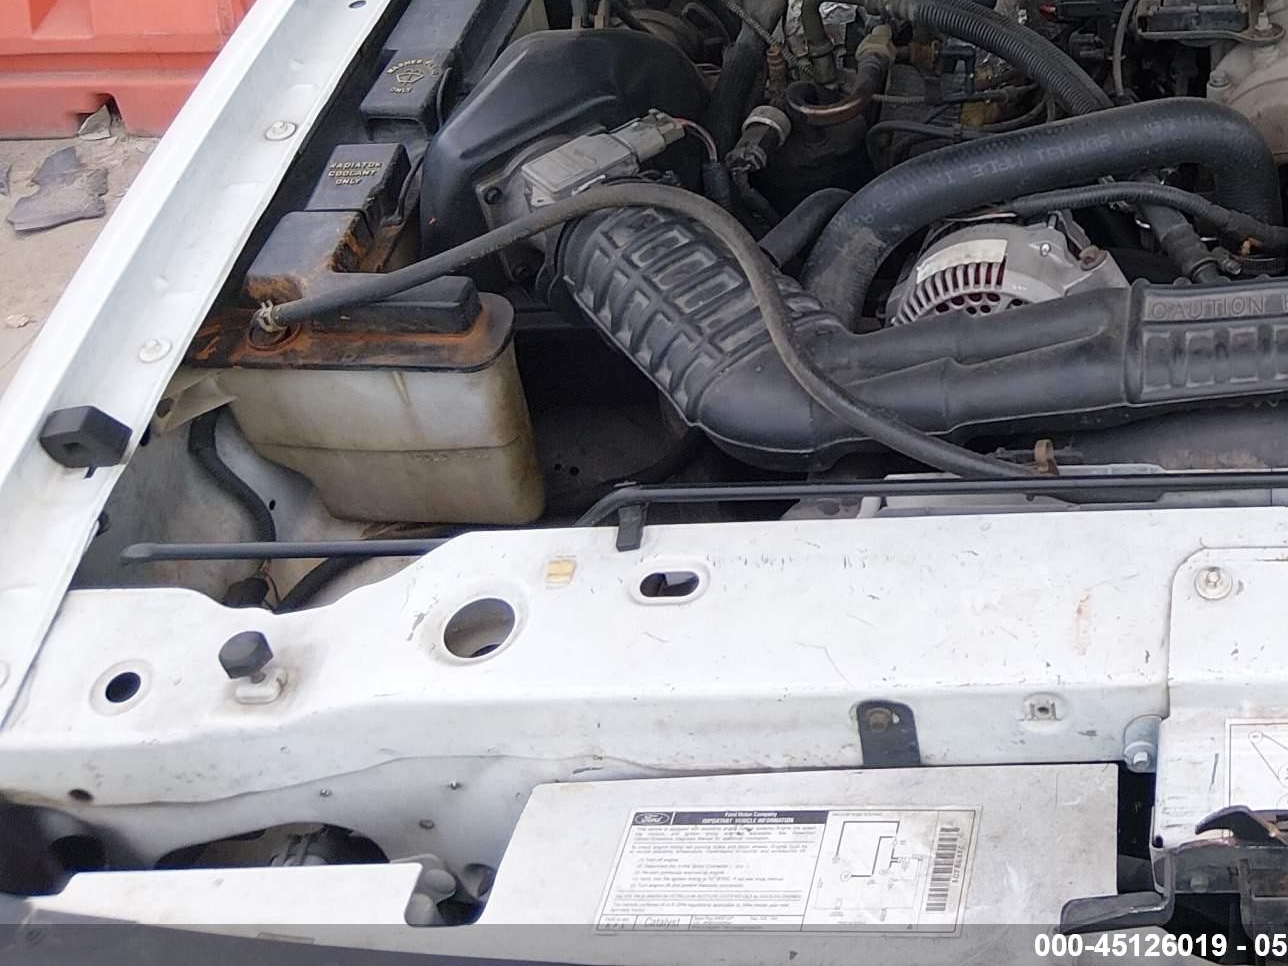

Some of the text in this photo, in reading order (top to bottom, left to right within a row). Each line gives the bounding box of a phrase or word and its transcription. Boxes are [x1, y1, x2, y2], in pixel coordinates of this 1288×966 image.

[1151, 294, 1266, 320] CAUTION
[641, 814, 662, 823] Ford
[644, 917, 681, 929] Catalyst
